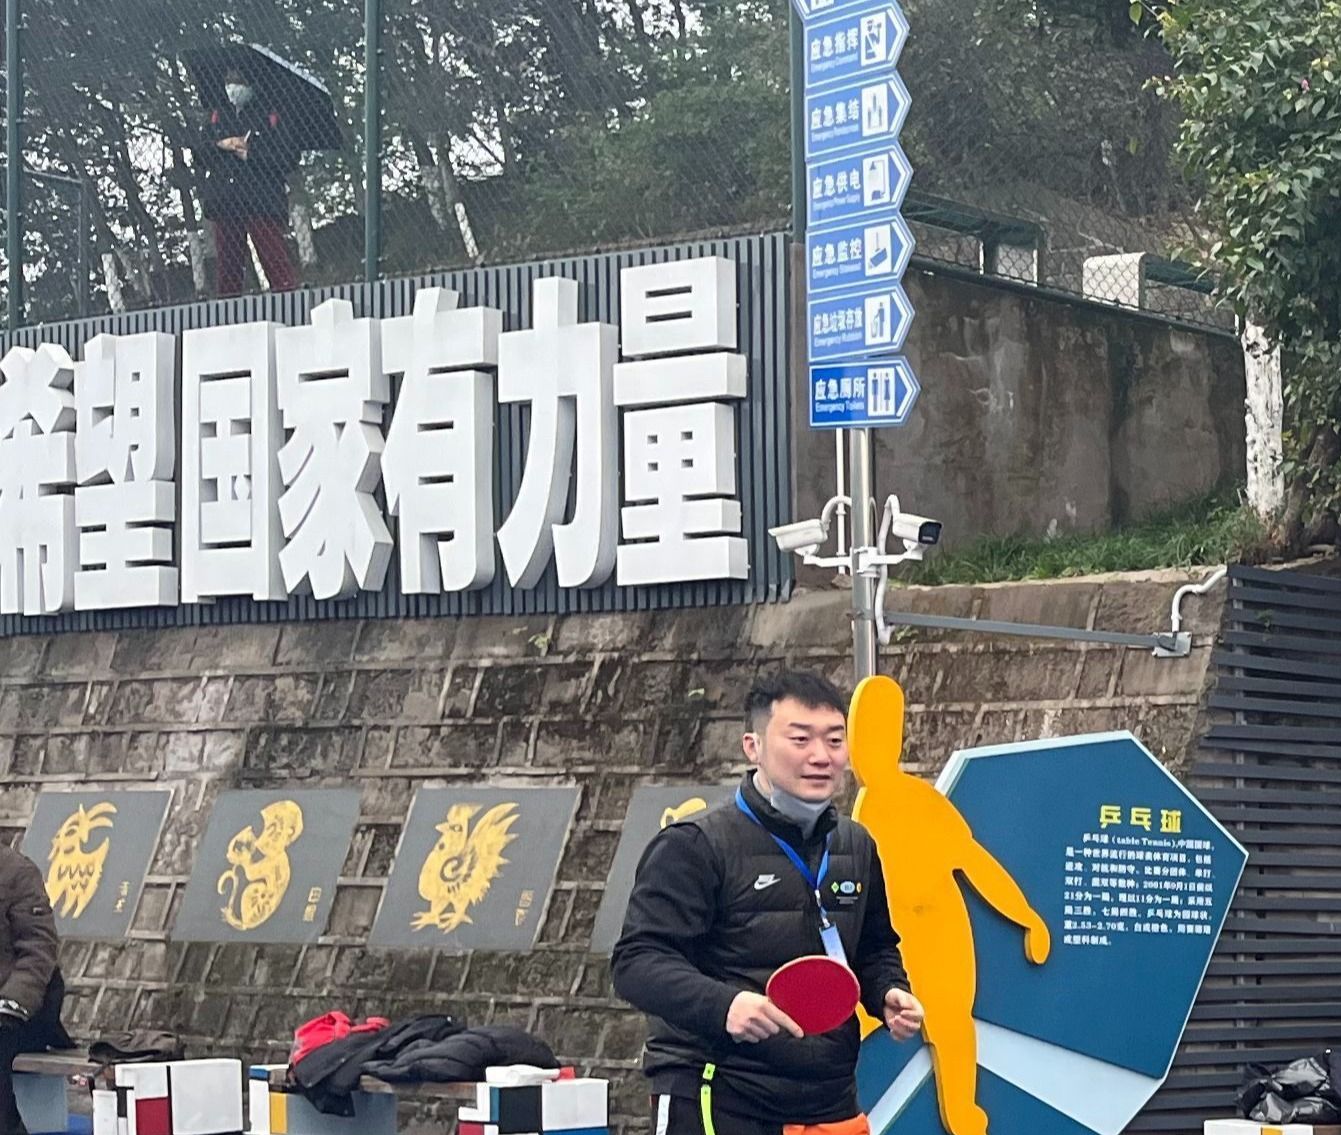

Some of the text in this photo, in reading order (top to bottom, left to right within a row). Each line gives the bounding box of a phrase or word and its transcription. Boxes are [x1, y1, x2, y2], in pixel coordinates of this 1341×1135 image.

[0, 255, 748, 617] 希望国家有力量
[1099, 804, 1182, 833] 乒乓球
